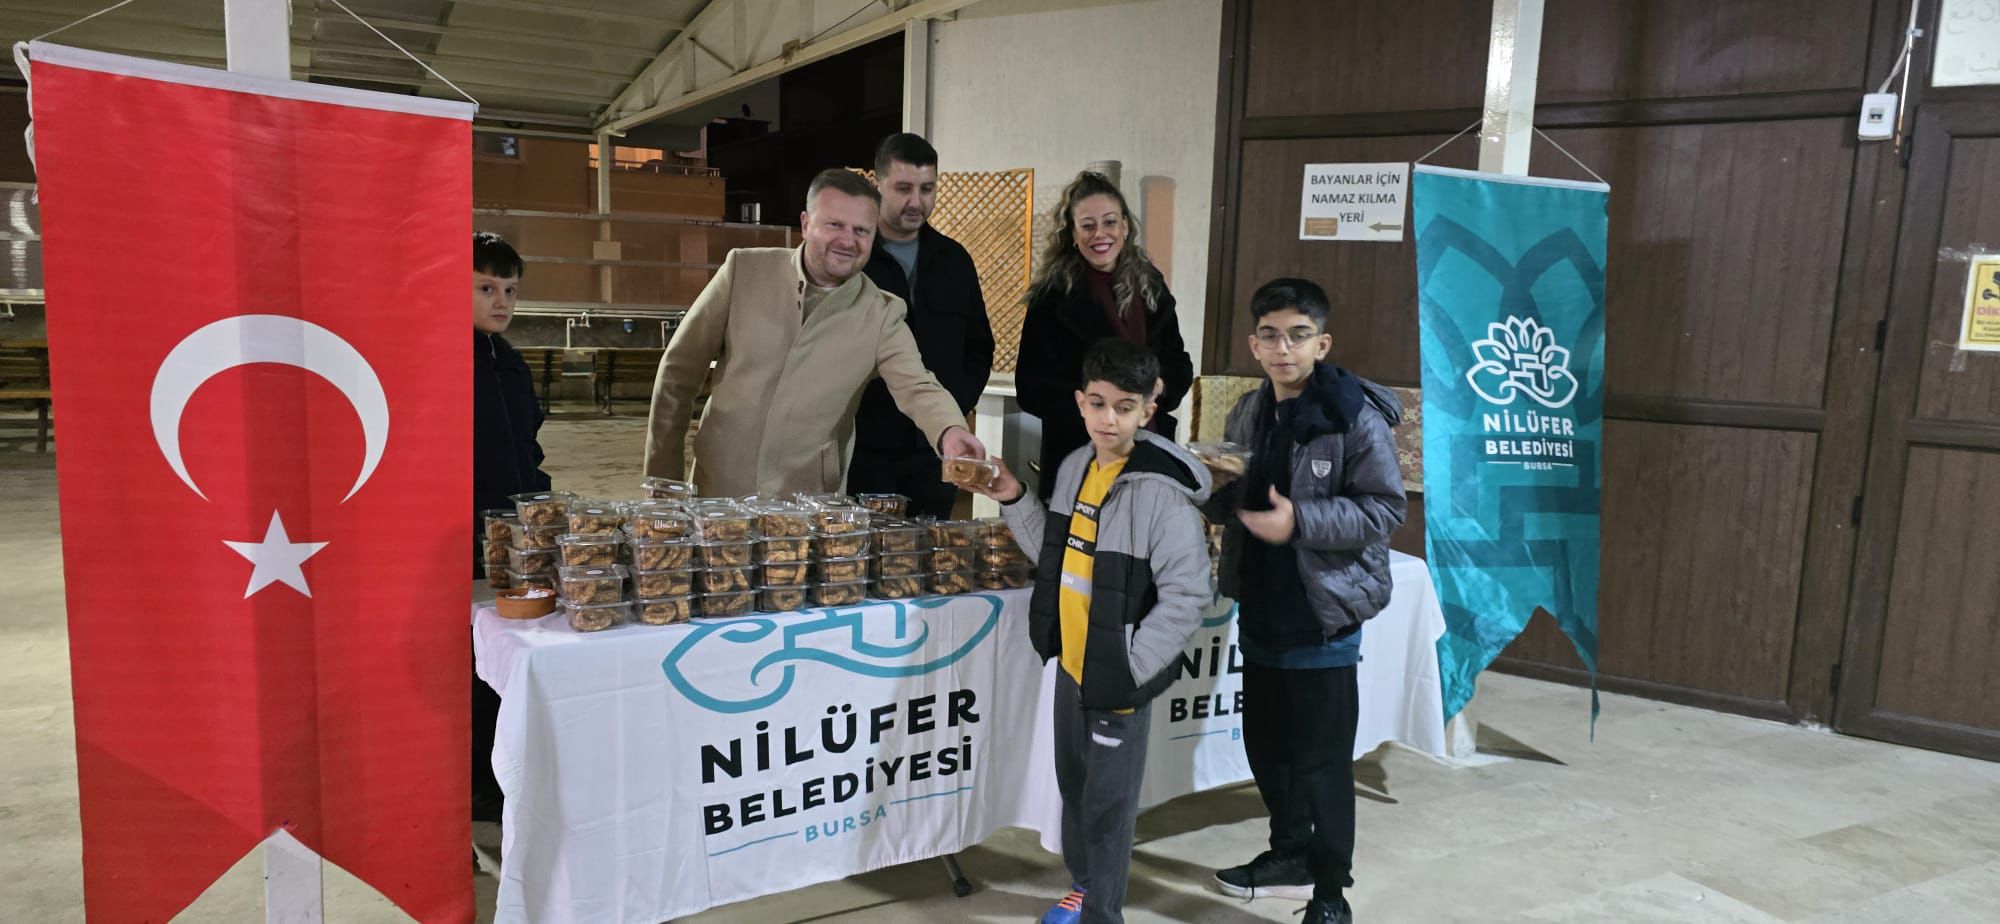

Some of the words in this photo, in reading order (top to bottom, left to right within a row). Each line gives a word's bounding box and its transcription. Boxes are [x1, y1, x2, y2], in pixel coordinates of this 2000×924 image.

[1311, 174, 1373, 185] BAYANLAR
[1376, 172, 1401, 186] İÇİN
[1312, 193, 1355, 204] NAMAZ
[1359, 193, 1396, 204] KILMA
[1340, 210, 1365, 223] YERİ
[1483, 409, 1574, 436] NİLÜFER
[1485, 437, 1573, 458] BELEDİYESİ
[1523, 462, 1553, 470] BURSA
[1175, 636, 1244, 680] NİL
[701, 688, 980, 784] NİLÜFER
[703, 735, 973, 835] BELEDİYESİ
[805, 804, 887, 842] BURSA
